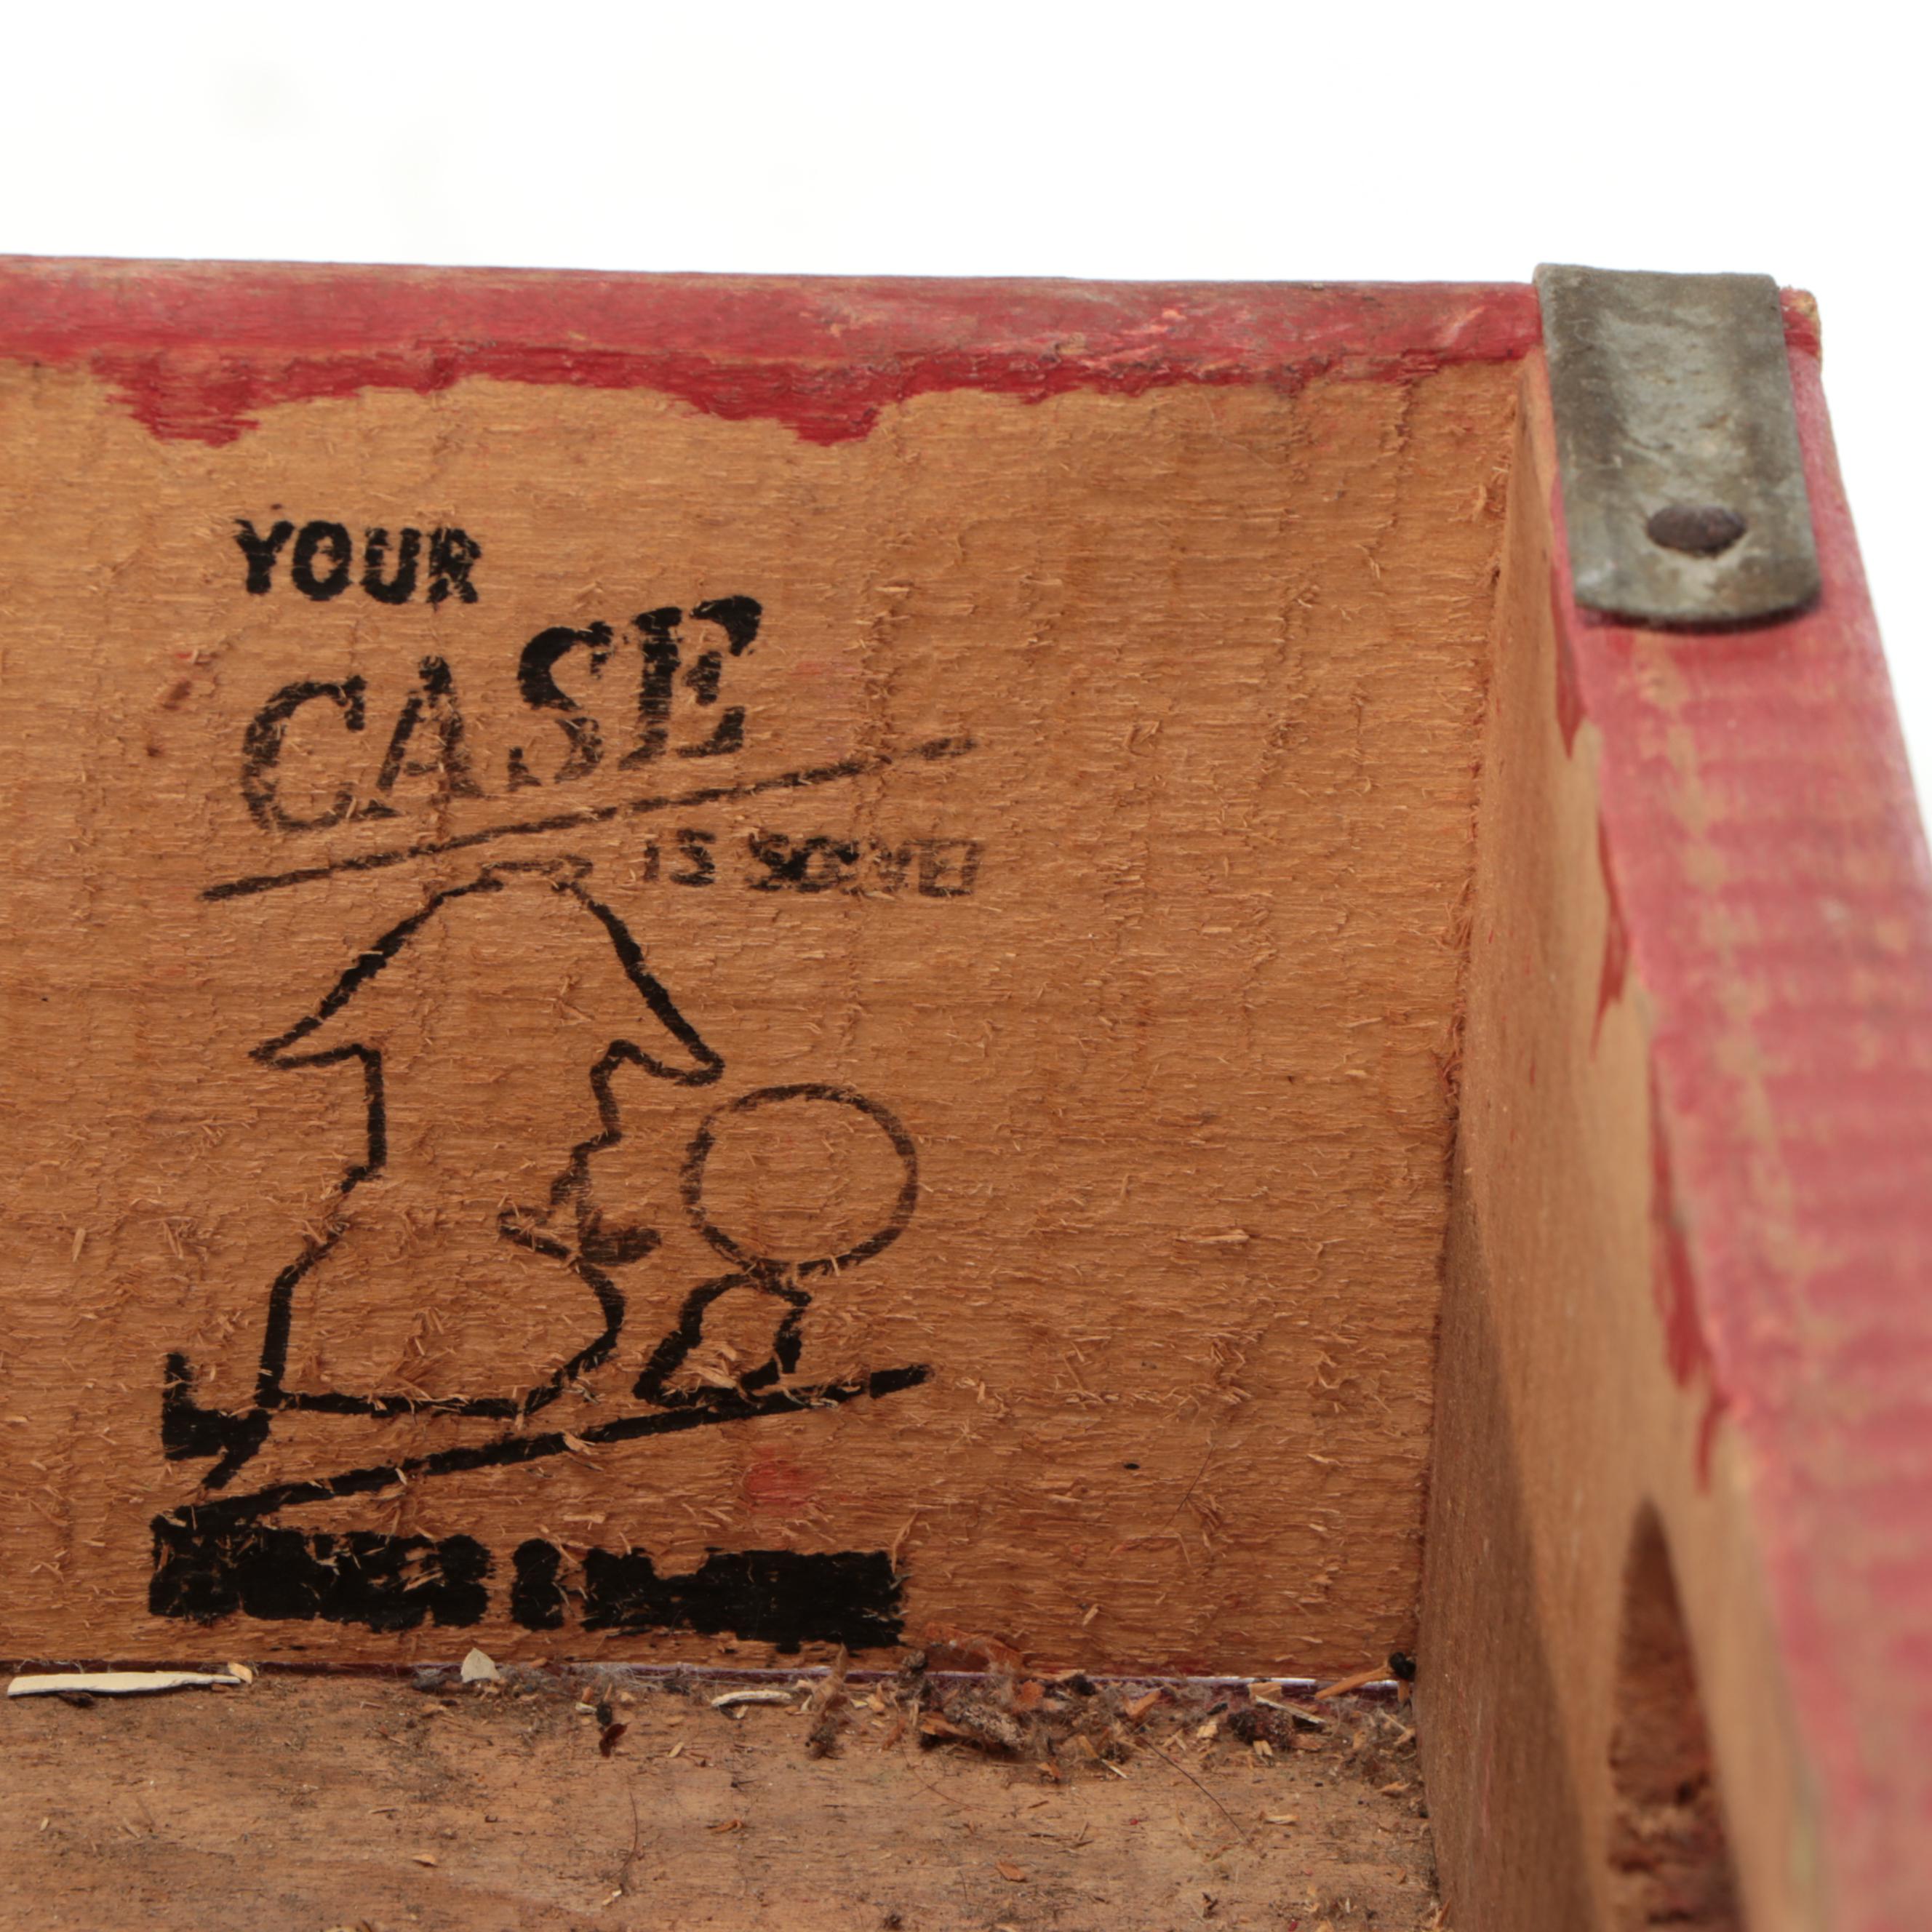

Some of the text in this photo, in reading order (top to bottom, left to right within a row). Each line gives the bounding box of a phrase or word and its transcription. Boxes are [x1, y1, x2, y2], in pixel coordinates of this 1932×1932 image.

[235, 519, 481, 605] YOUR
[242, 595, 762, 831] CASE
[644, 829, 714, 886] IS
